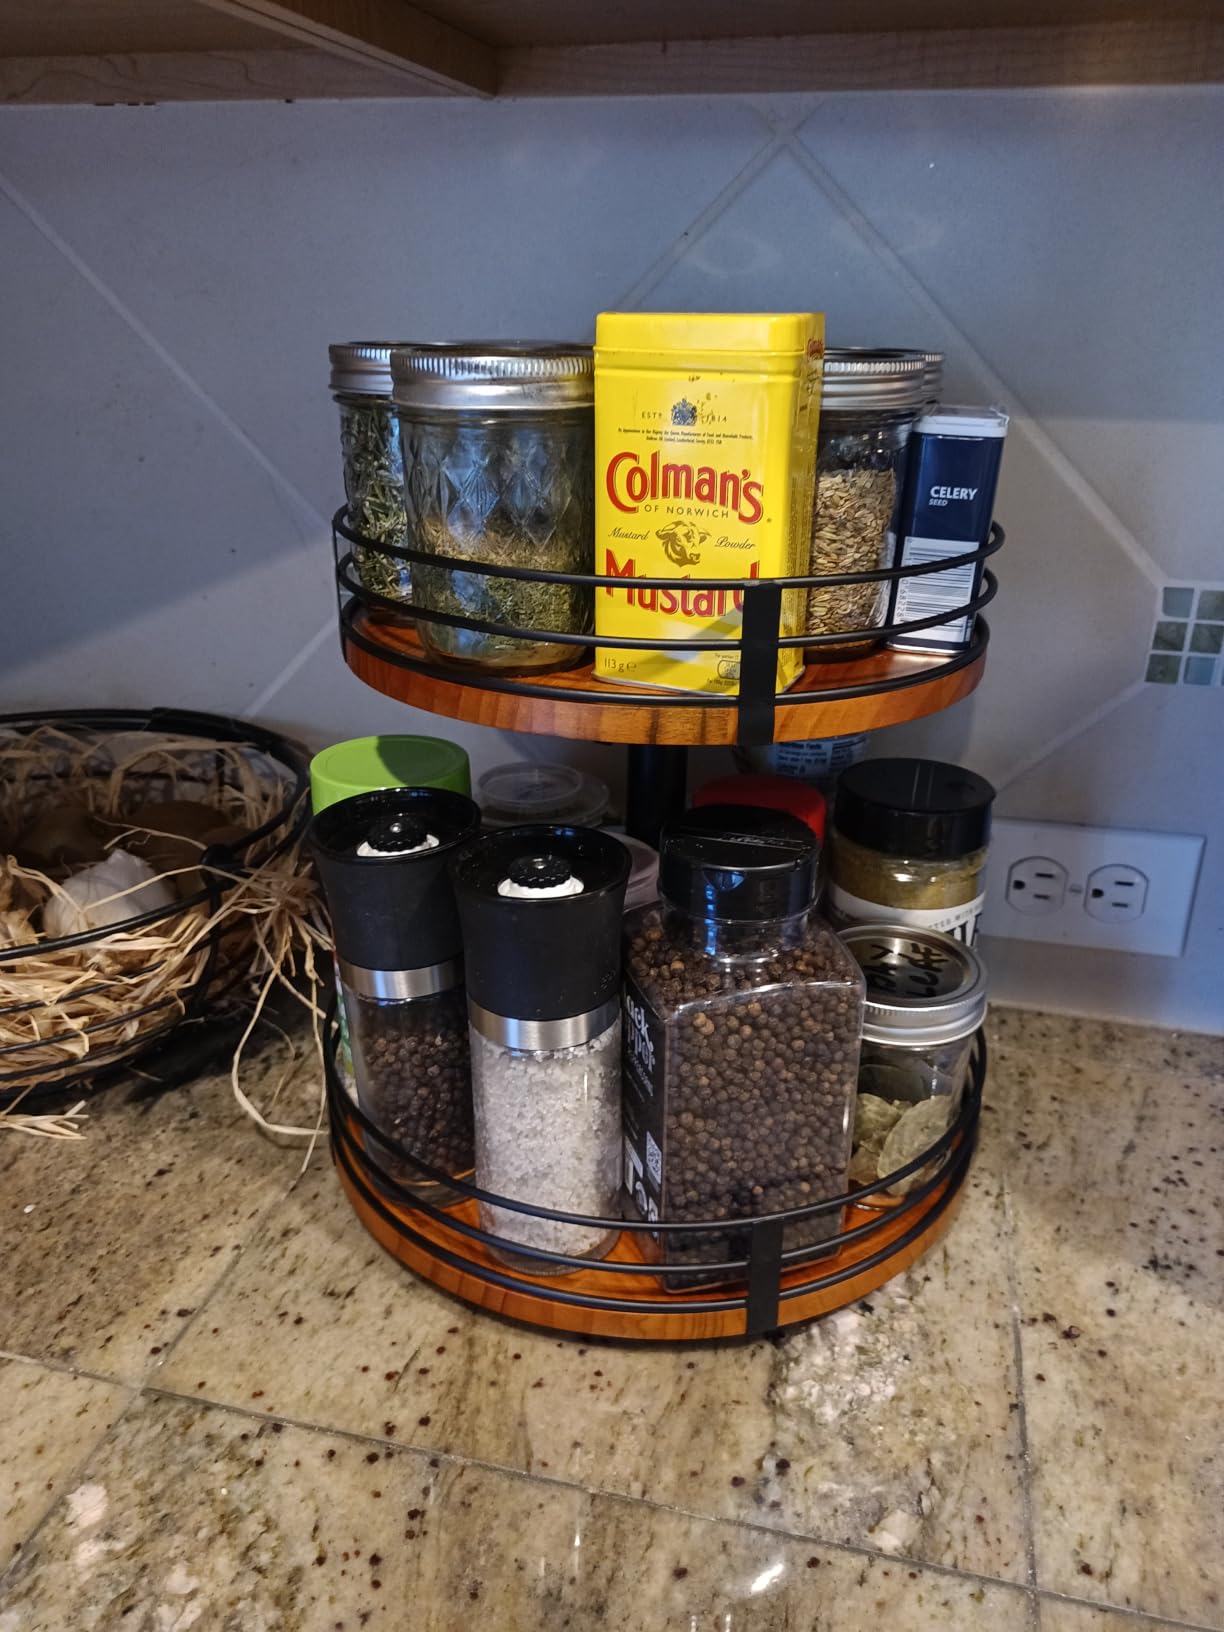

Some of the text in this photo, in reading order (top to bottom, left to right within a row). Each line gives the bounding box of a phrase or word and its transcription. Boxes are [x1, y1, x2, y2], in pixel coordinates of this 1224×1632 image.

[606, 450, 764, 525] Colman's
[930, 486, 978, 501] CELERY
[928, 498, 949, 507] SEED
[644, 504, 729, 519] OF NORWICH
[607, 527, 756, 550] Mustard Powder
